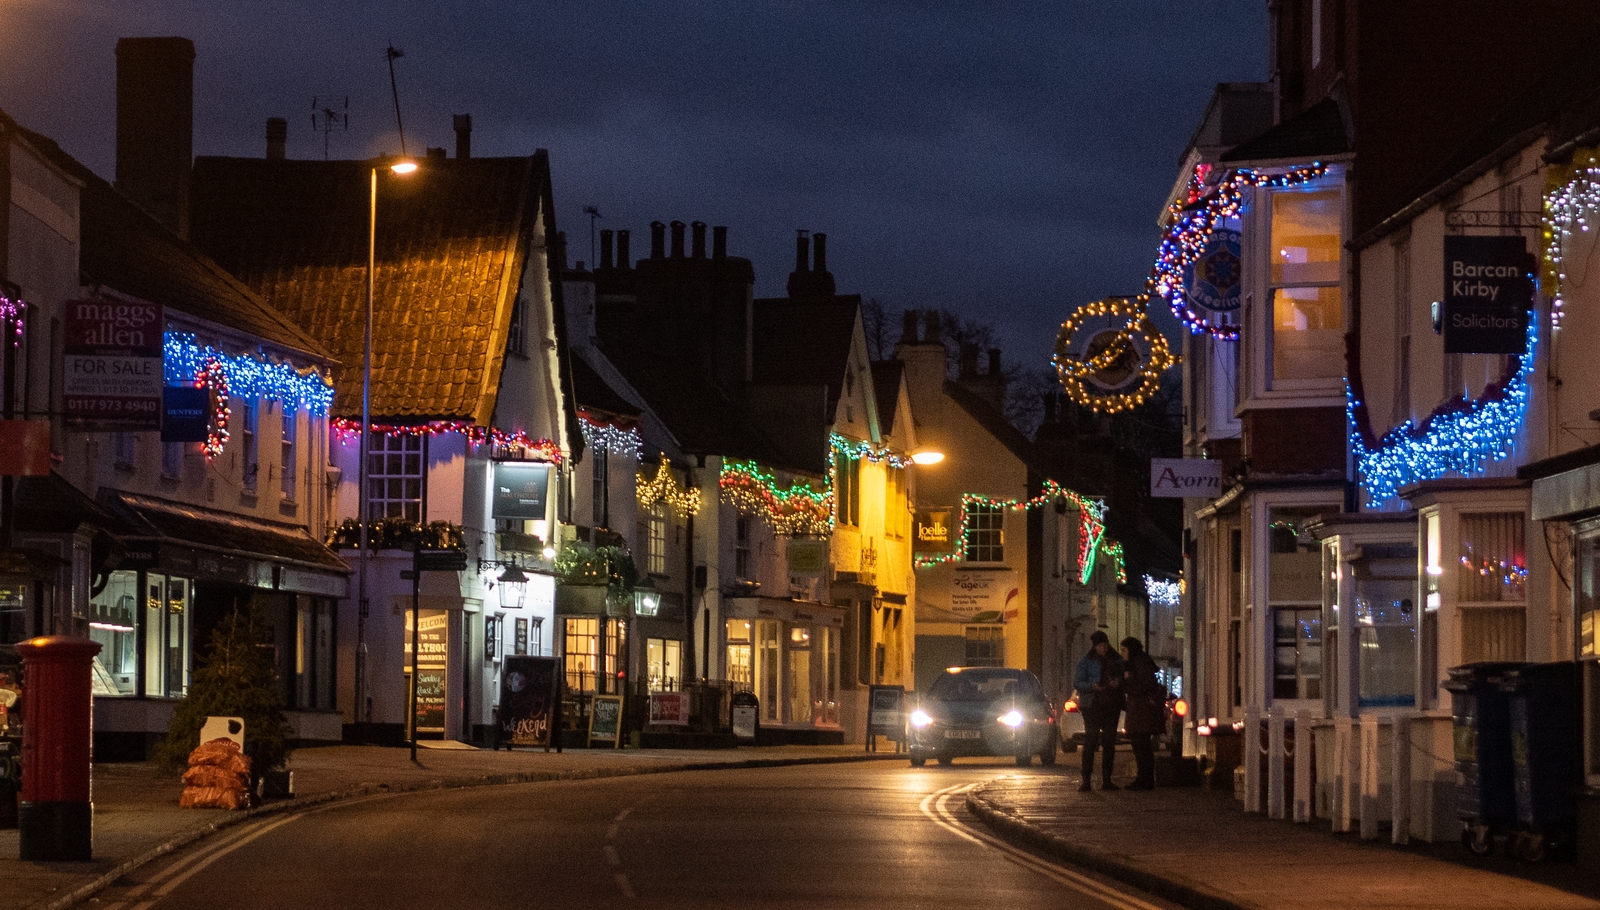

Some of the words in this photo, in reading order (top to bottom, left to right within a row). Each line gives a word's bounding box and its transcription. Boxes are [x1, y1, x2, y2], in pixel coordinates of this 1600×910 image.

[1453, 261, 1518, 277] Barcan
[1453, 281, 1499, 301] Kirby
[77, 304, 156, 328] maggs
[1453, 313, 1518, 328] Solicitors
[85, 322, 144, 346] allen
[74, 359, 106, 374] FOR
[112, 360, 151, 375] SALE
[68, 399, 96, 410] 0117
[99, 399, 121, 411] 973
[124, 400, 156, 412] 4940
[1155, 467, 1220, 489] Acorn
[918, 522, 948, 538] Joelle
